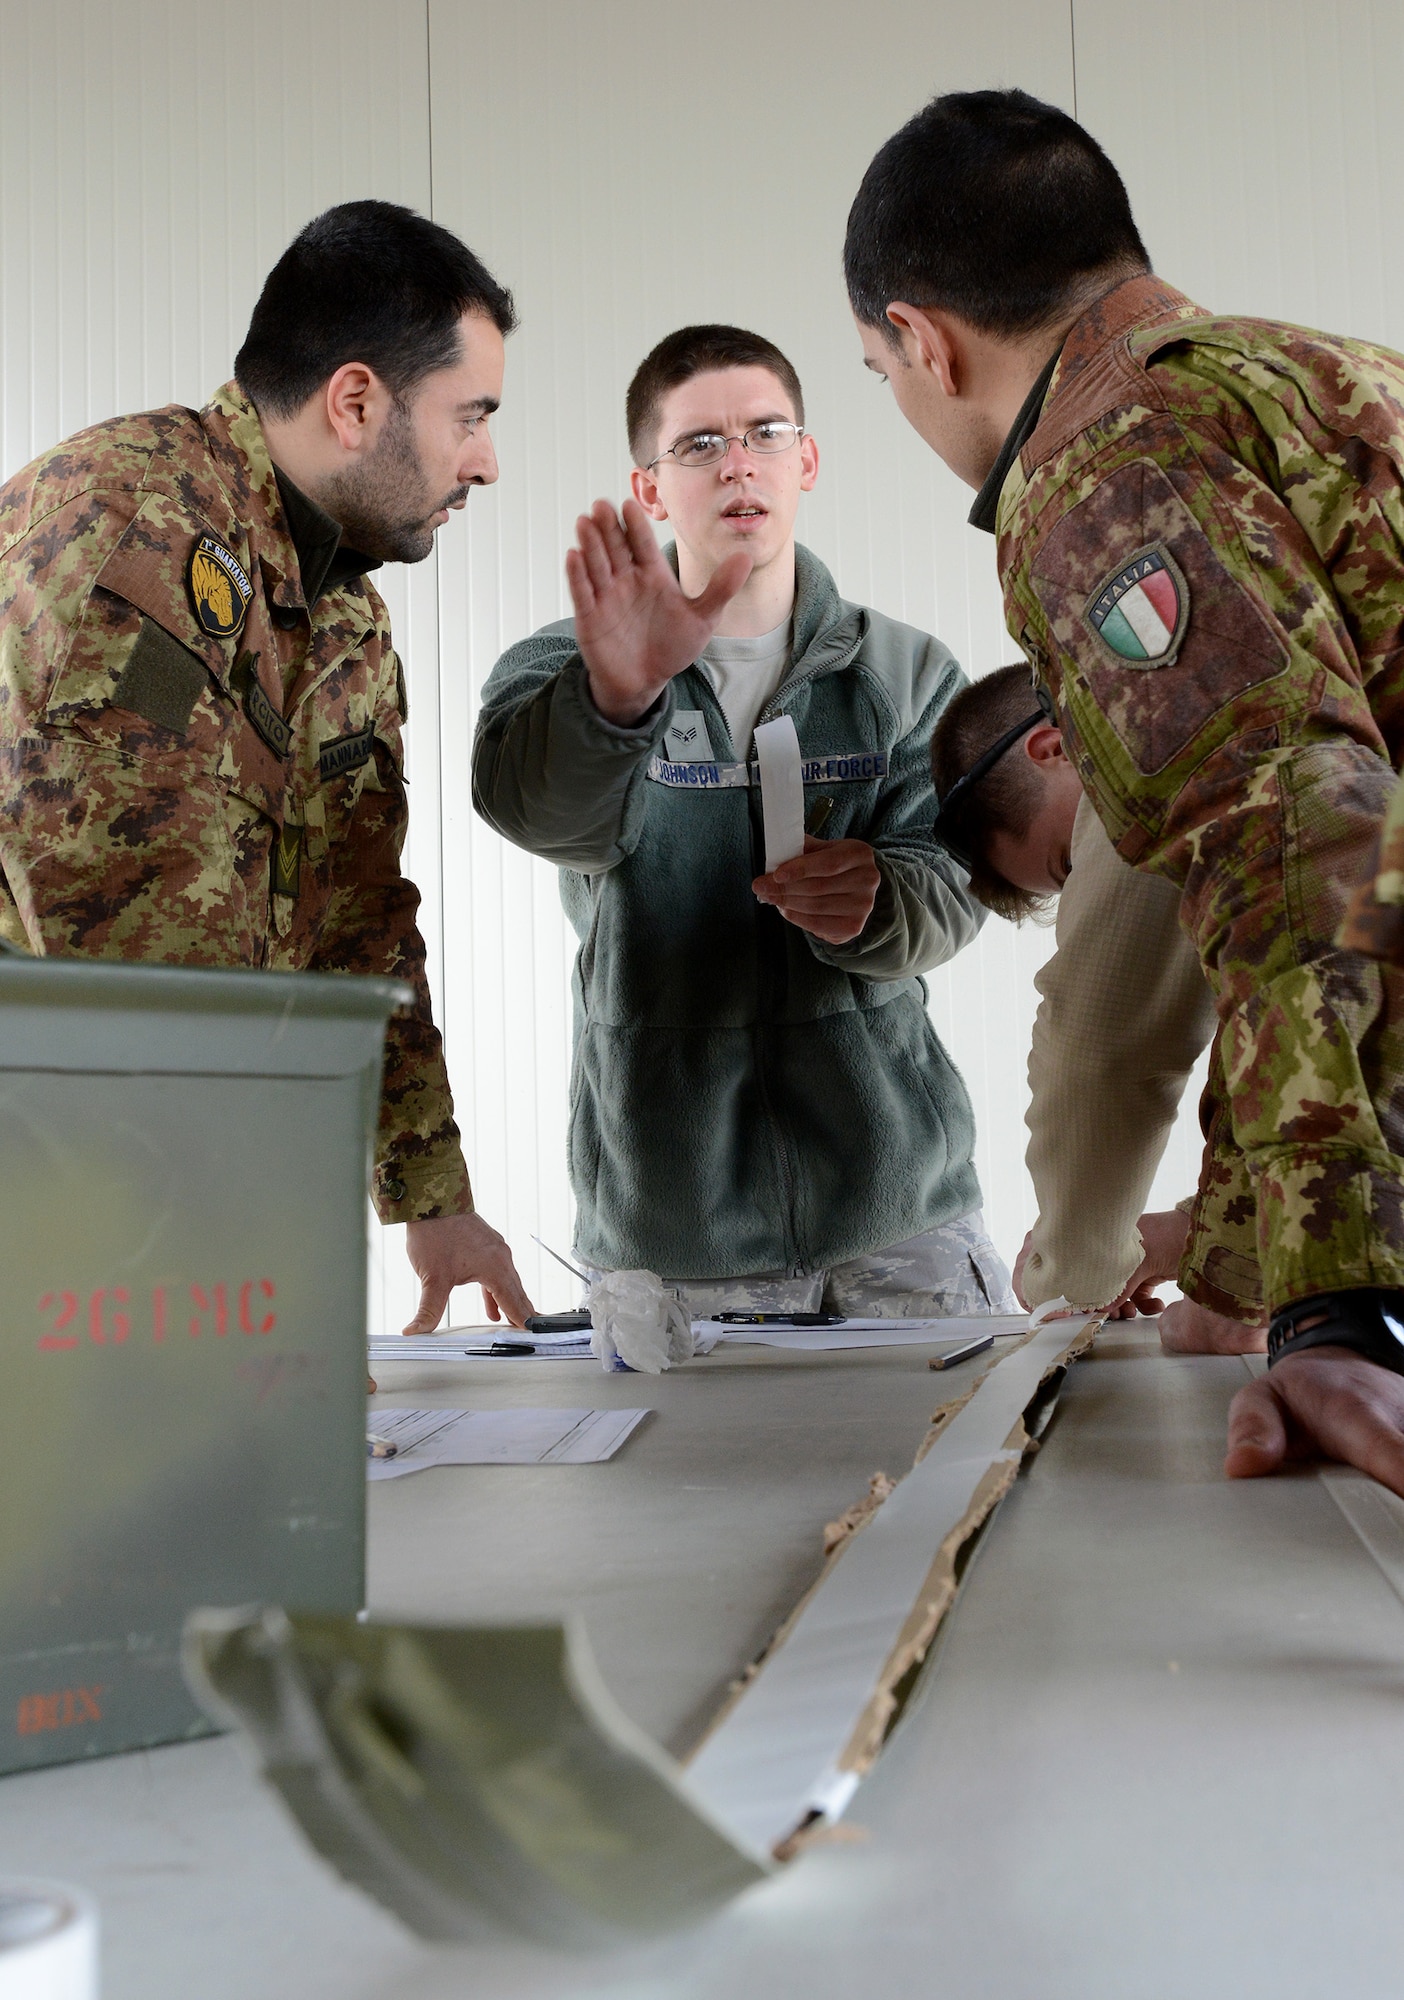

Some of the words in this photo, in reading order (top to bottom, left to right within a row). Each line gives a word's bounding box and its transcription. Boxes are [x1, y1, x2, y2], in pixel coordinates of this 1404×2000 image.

[214, 545, 252, 597] GUASTATORI
[1094, 560, 1153, 617] ITALIA
[658, 762, 720, 785] JOHNSON
[826, 755, 885, 778] FORCE
